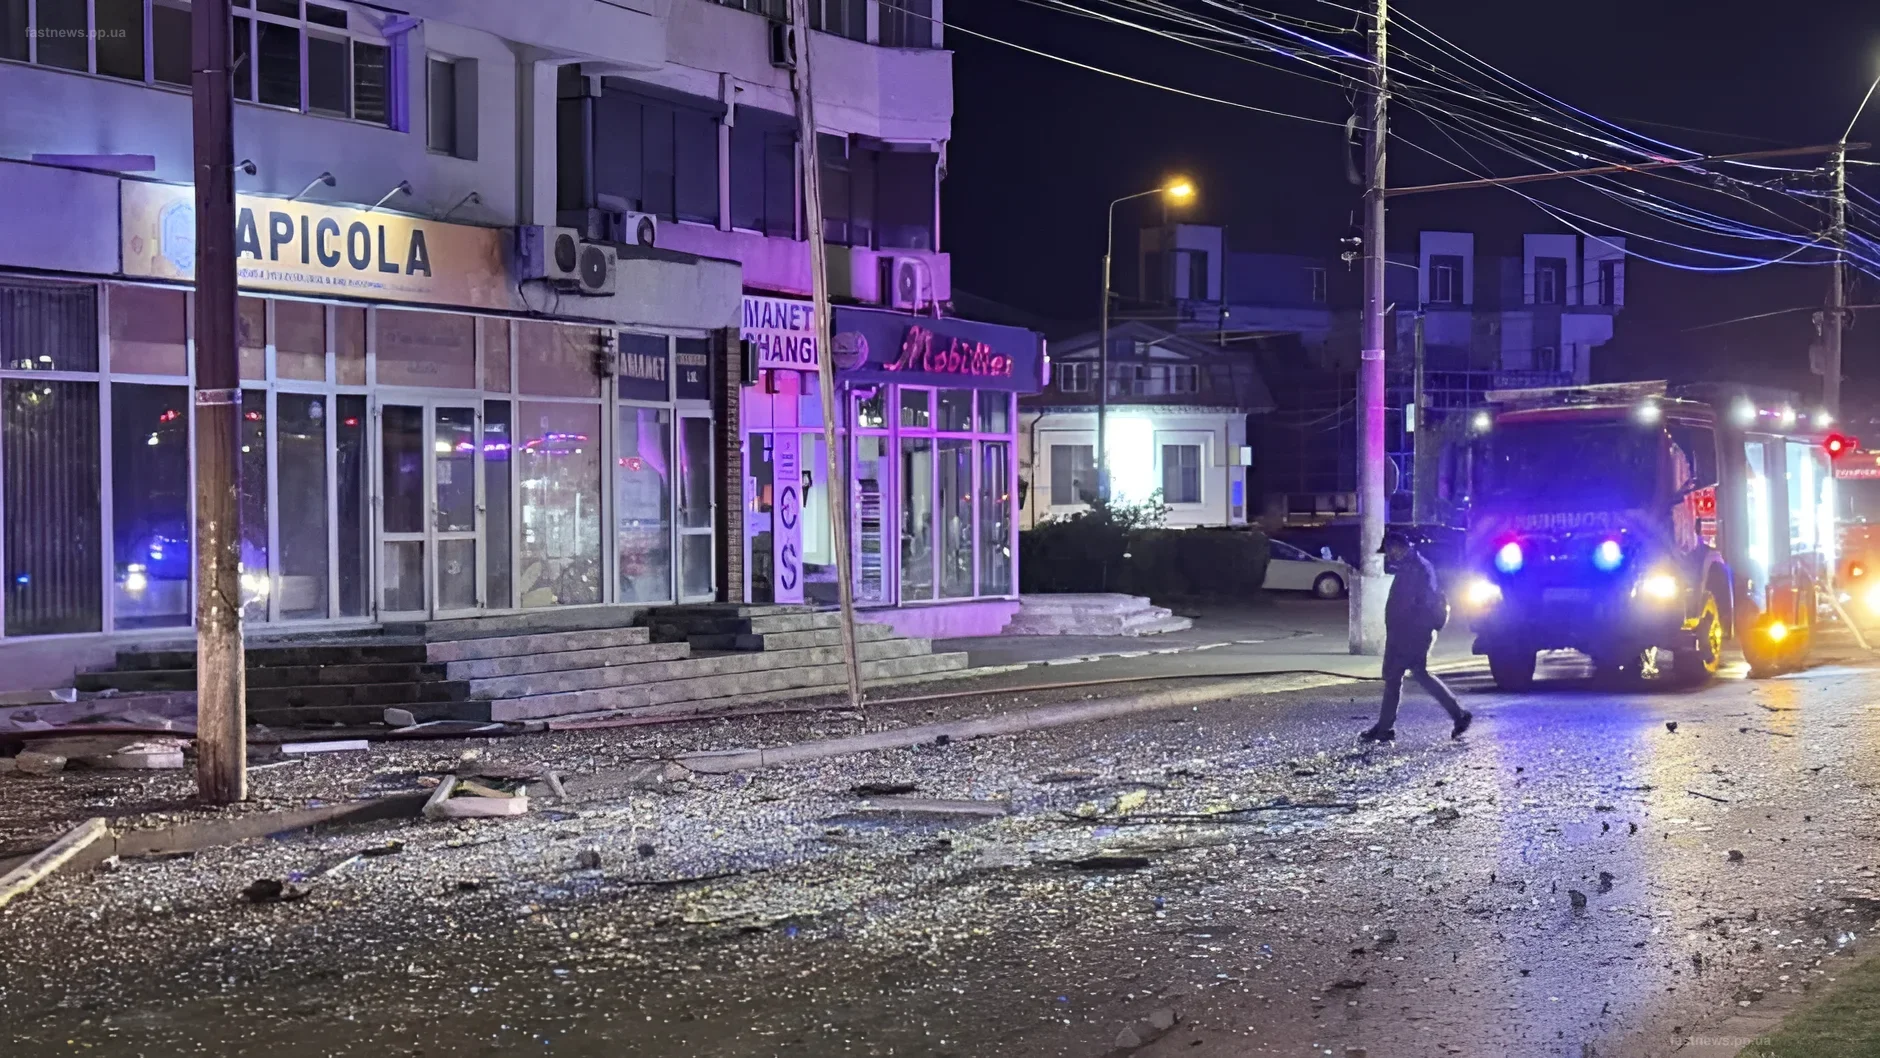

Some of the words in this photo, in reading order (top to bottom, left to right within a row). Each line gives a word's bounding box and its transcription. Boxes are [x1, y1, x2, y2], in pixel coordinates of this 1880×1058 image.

[236, 207, 432, 277] APICOLA
[744, 299, 815, 331] MANET
[745, 333, 819, 365] HANG
